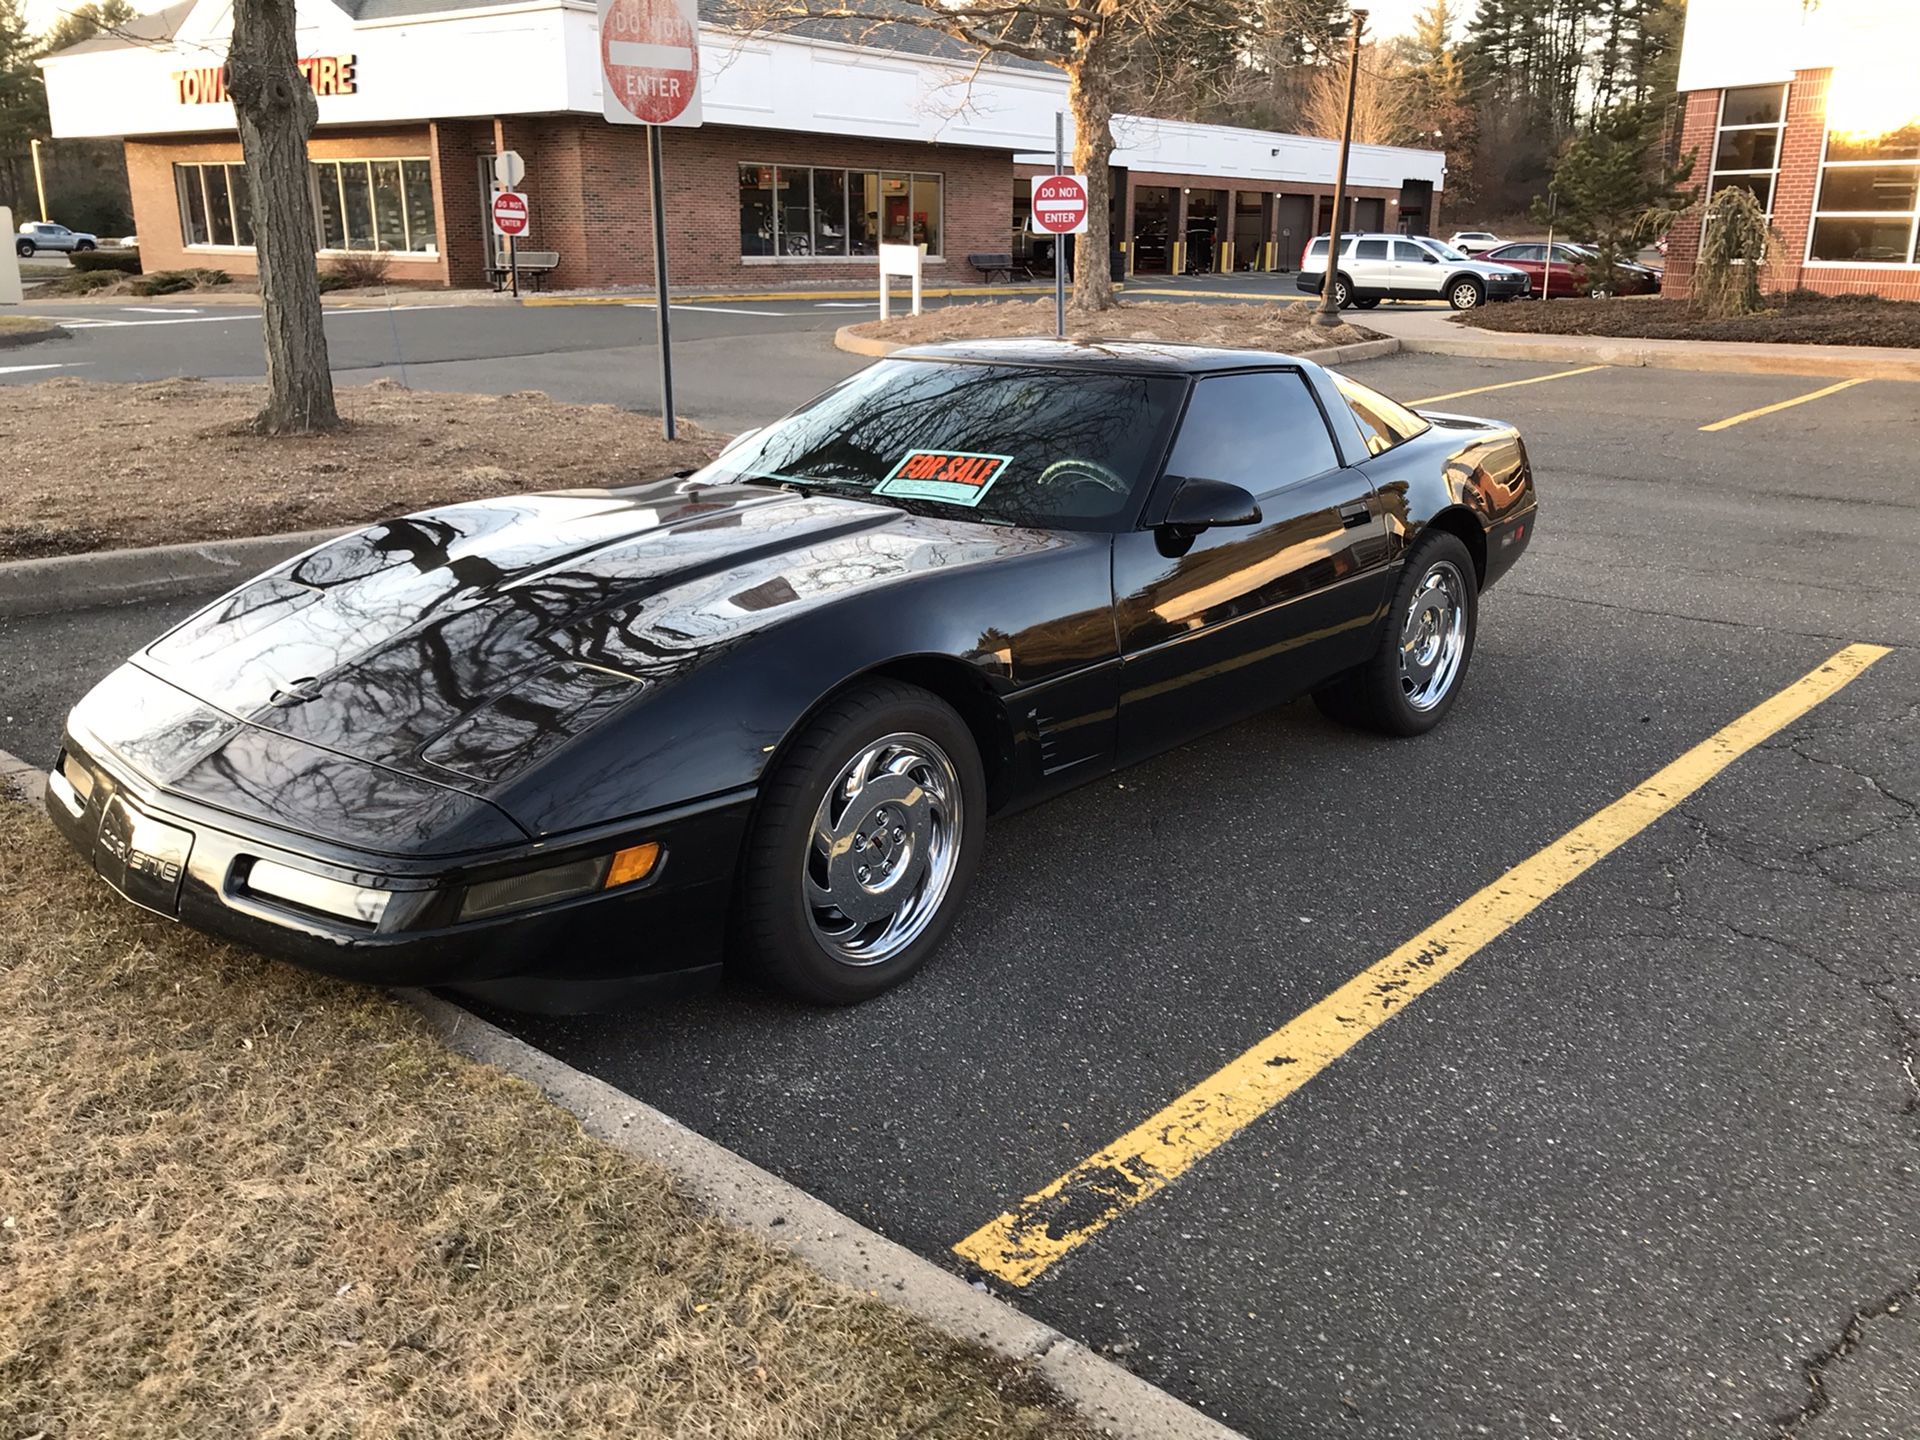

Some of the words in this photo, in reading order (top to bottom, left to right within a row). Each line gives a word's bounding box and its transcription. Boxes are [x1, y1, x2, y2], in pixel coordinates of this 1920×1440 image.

[616, 11, 640, 34] DO
[626, 74, 680, 98] ENTER
[1041, 187, 1056, 198] DO
[1059, 187, 1078, 198] NOT
[497, 200, 508, 208] DO
[509, 201, 522, 209] NOT
[501, 219, 521, 227] ENTER
[1044, 213, 1076, 223] ENTER
[896, 453, 947, 480] FOR
[937, 455, 1001, 486] SALE
